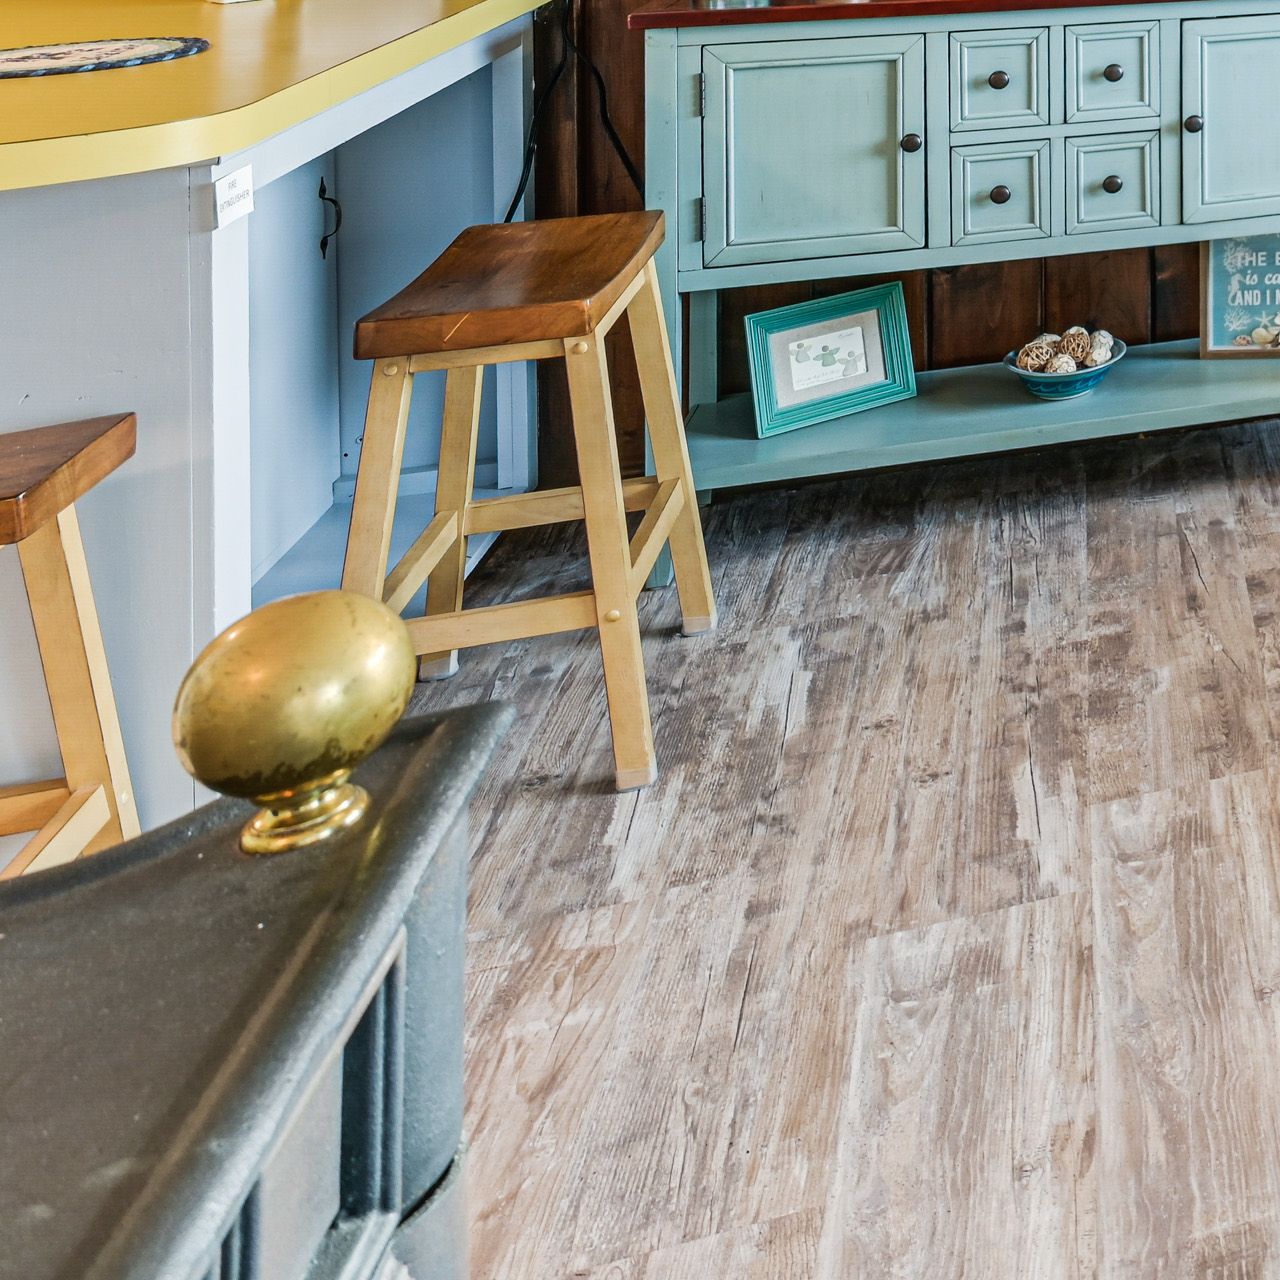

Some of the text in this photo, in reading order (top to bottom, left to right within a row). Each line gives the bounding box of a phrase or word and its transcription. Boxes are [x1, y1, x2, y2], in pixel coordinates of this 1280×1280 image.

[1237, 251, 1267, 267] THE
[1245, 269, 1259, 286] is
[1235, 289, 1261, 306] AND
[1266, 289, 1271, 306] I
